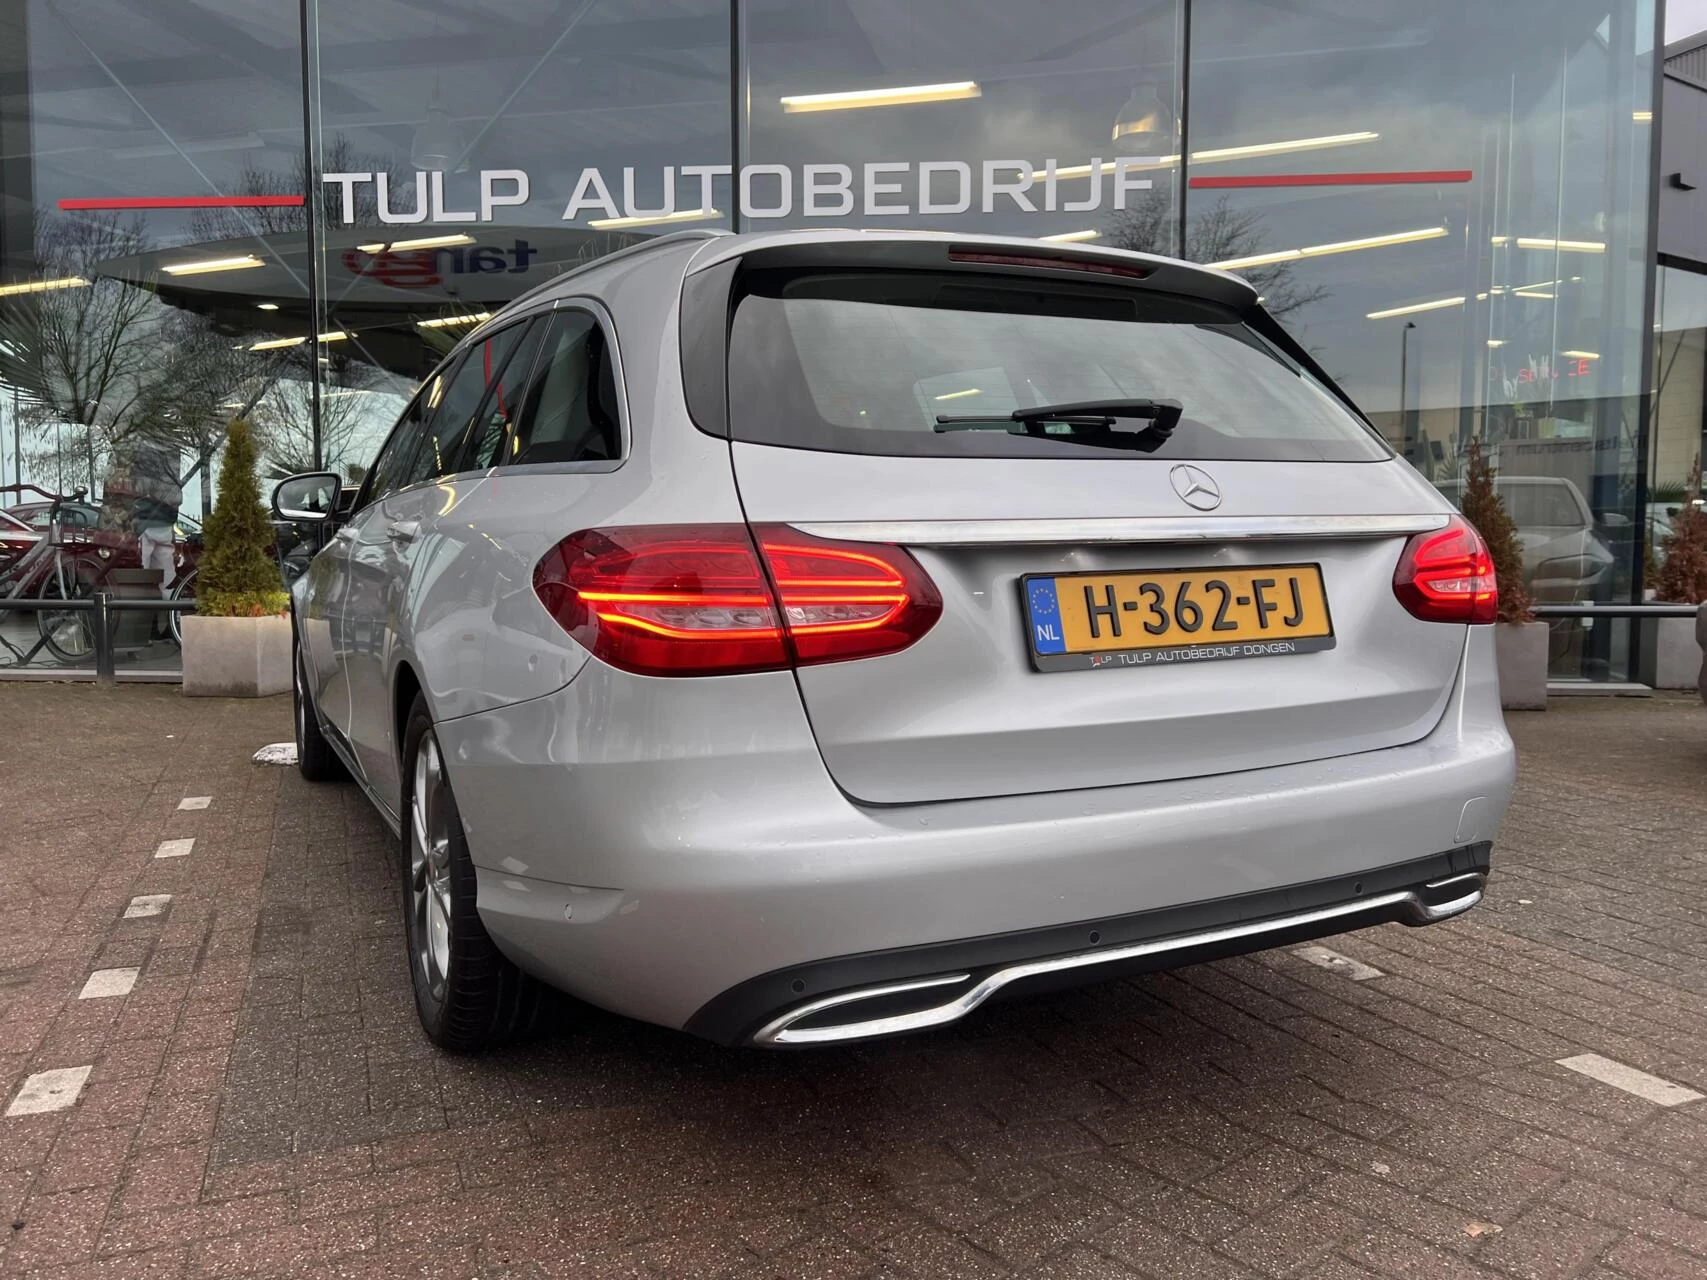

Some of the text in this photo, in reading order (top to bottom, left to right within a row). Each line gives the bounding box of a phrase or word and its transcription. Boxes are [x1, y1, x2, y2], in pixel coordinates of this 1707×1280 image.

[323, 157, 1161, 224] TULP AUTOBEDRIJF
[1084, 577, 1304, 639] H-362-FJ
[1037, 625, 1060, 641] NL
[1118, 642, 1295, 664] TULP AUTOBEDRIJF DONGEN
